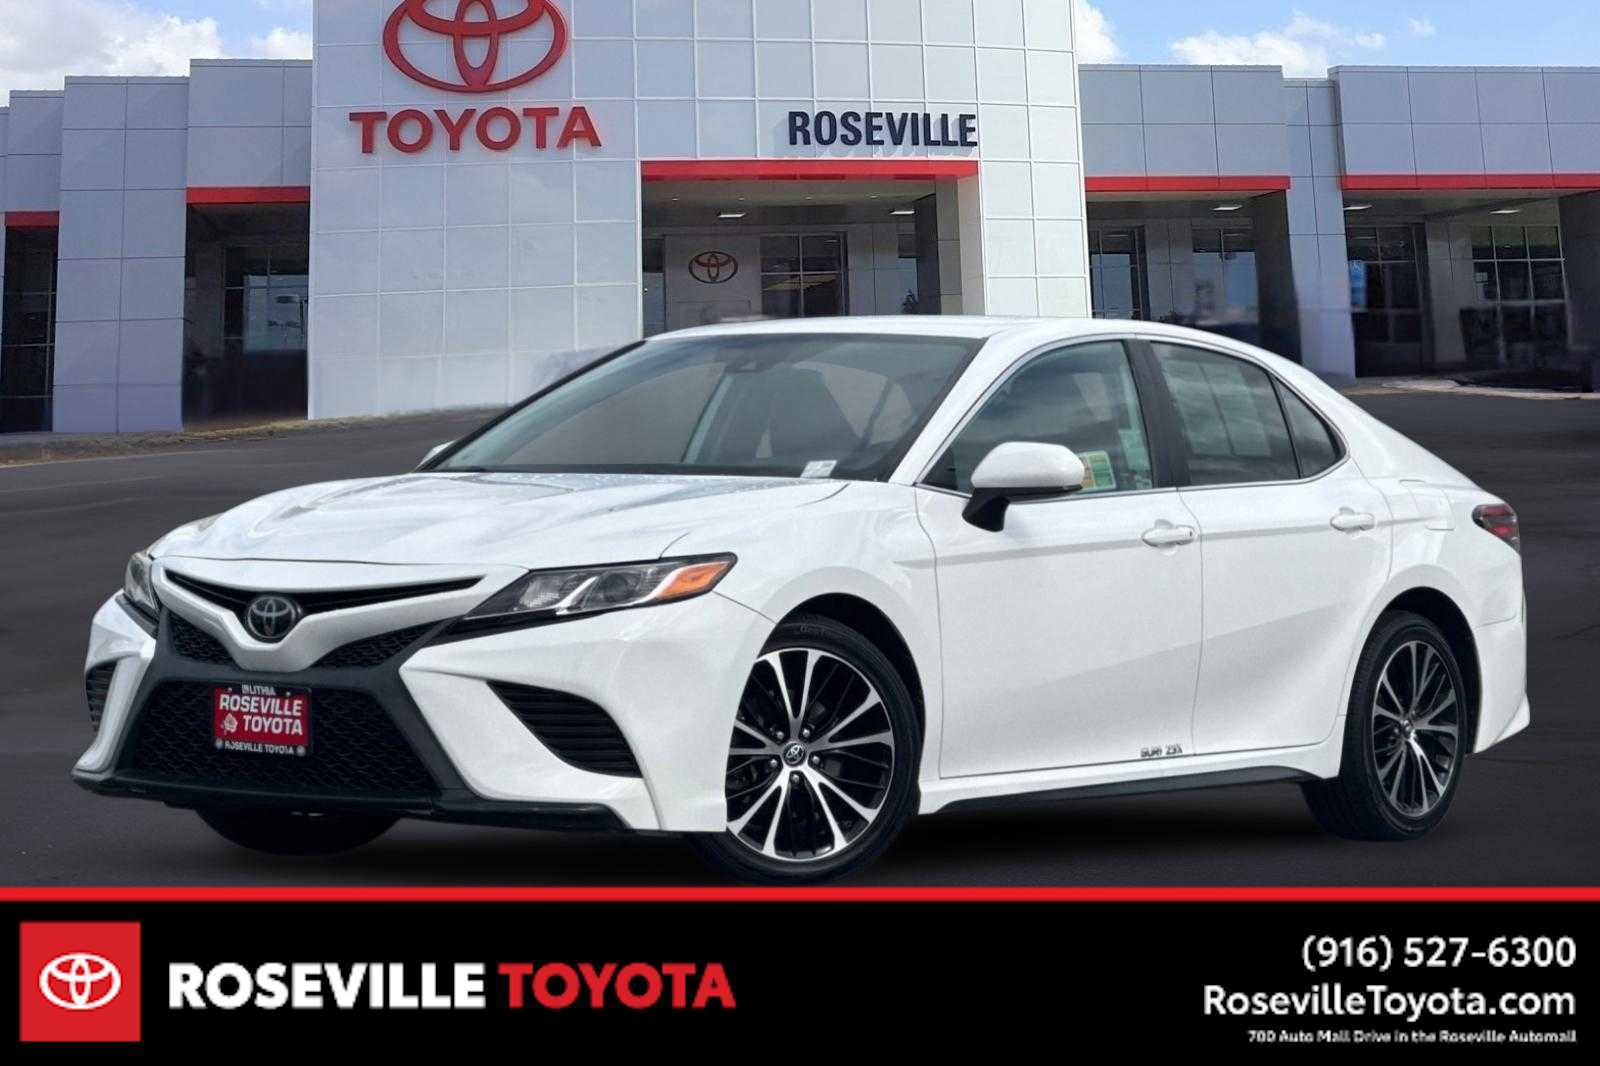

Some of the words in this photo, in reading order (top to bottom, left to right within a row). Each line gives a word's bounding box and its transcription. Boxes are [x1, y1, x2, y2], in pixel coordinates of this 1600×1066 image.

[349, 106, 602, 154] TOYOTA
[788, 110, 978, 147] ROSEVILLE
[219, 694, 303, 717] ROSEVILLE
[242, 715, 303, 736] TOYOTA
